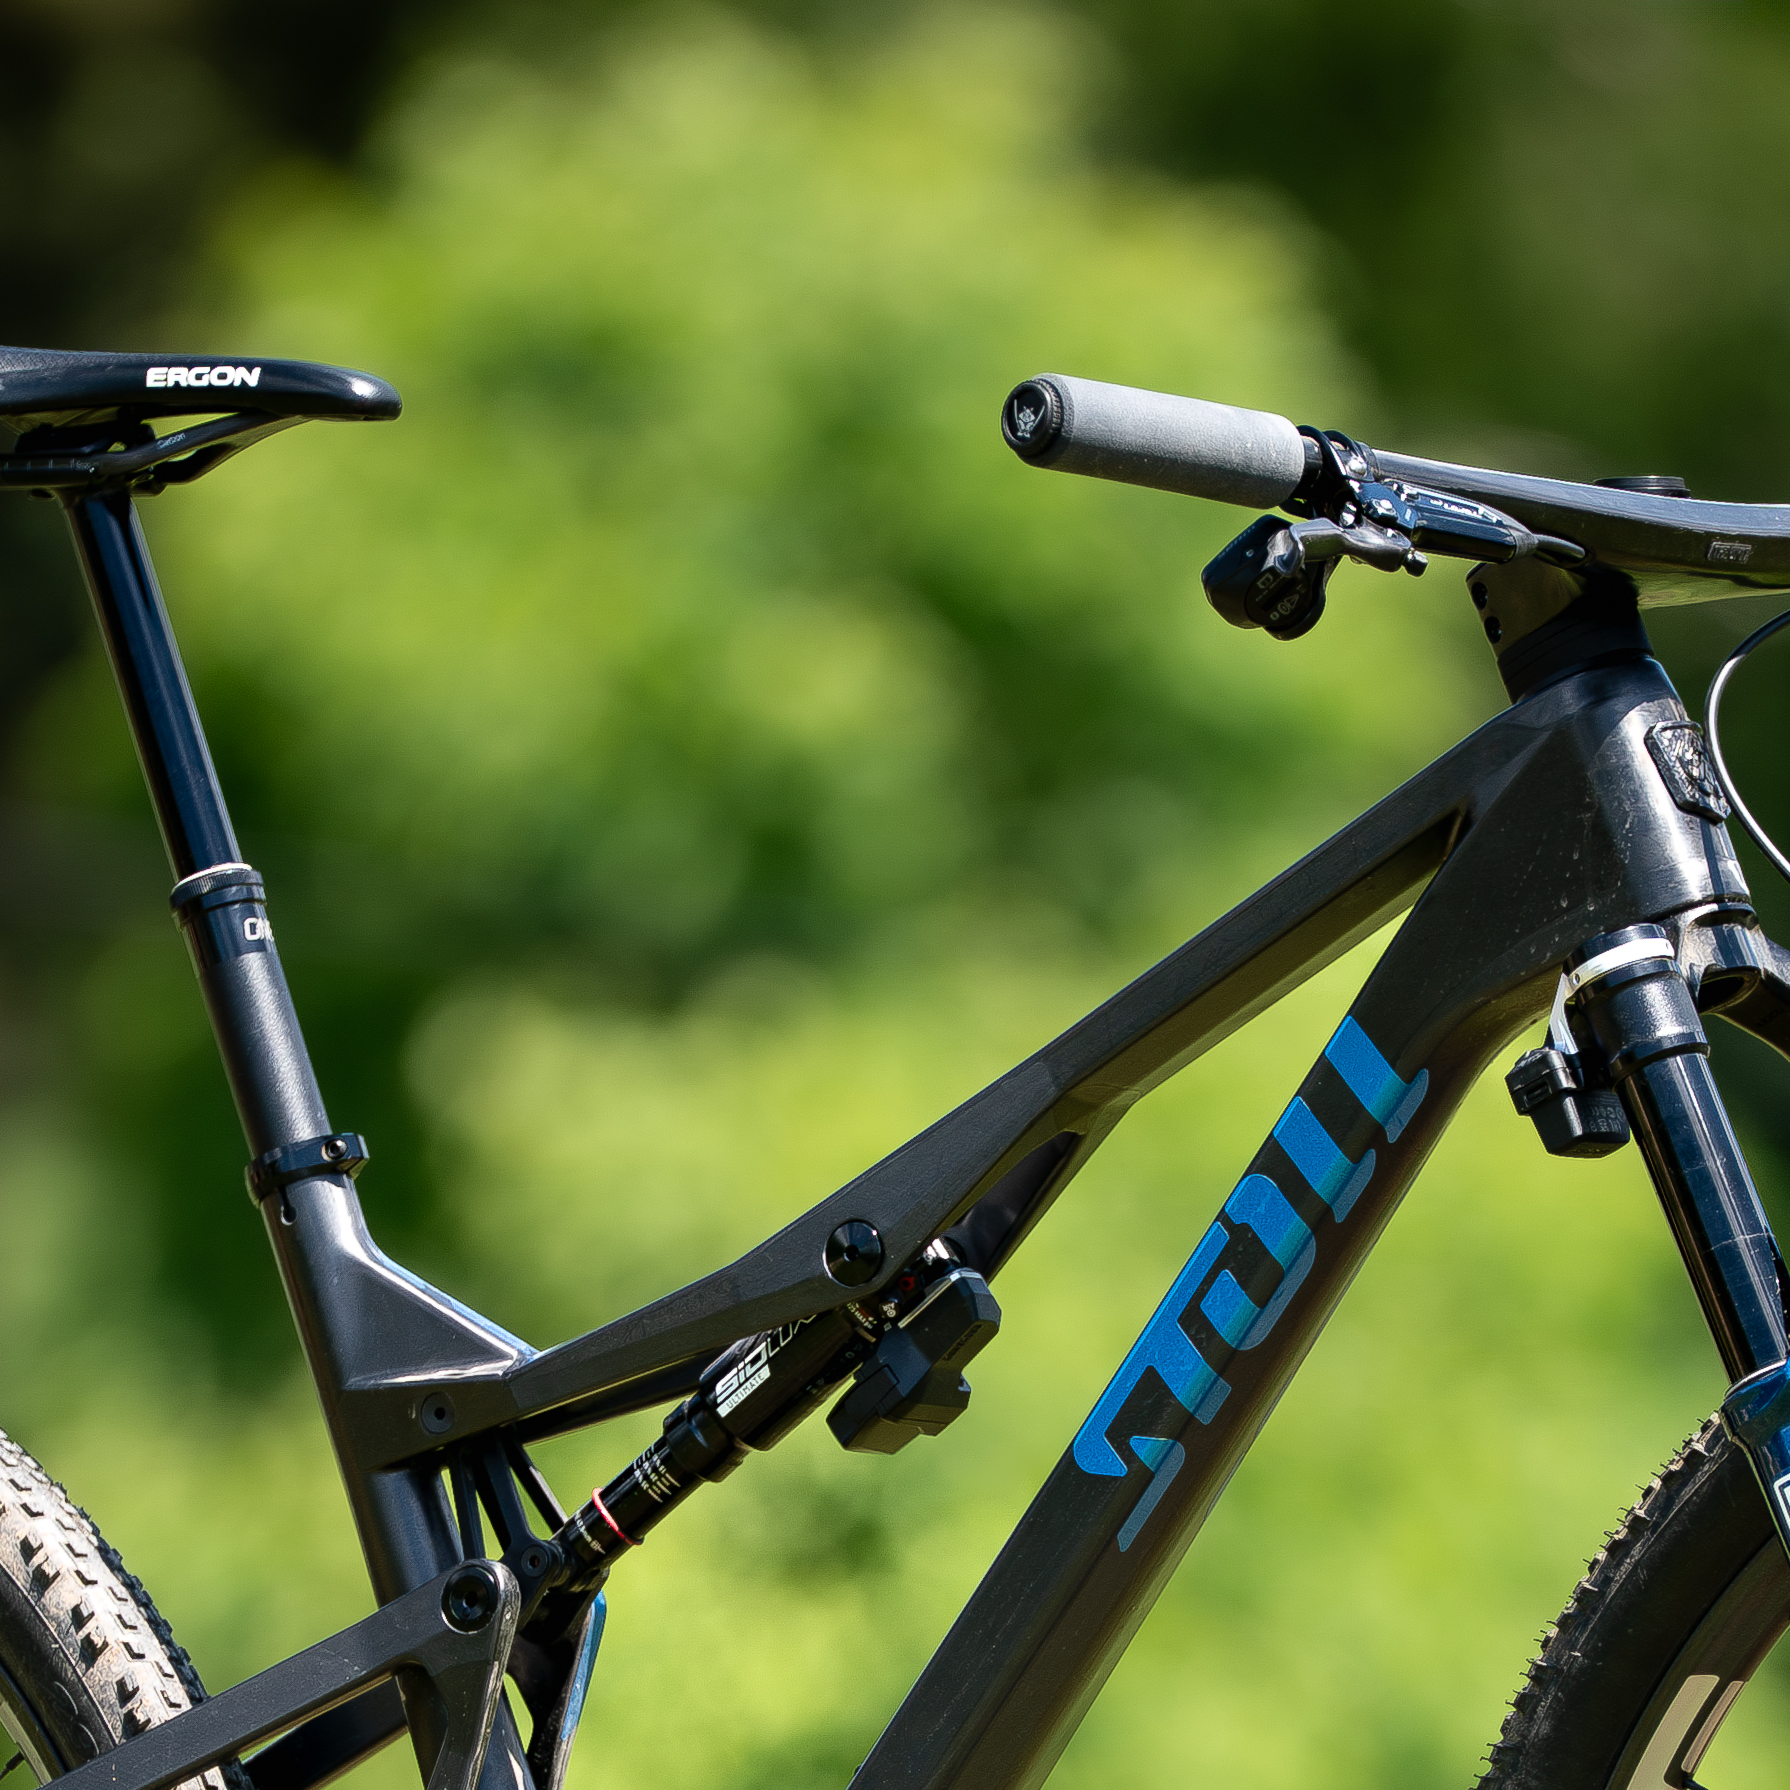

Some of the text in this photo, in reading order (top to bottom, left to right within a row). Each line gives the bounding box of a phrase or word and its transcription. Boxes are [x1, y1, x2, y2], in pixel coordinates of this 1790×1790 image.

[145, 366, 261, 389] ERGON
[1073, 1015, 1429, 1552] STOLL
[725, 1372, 765, 1409] ULTIMATE
